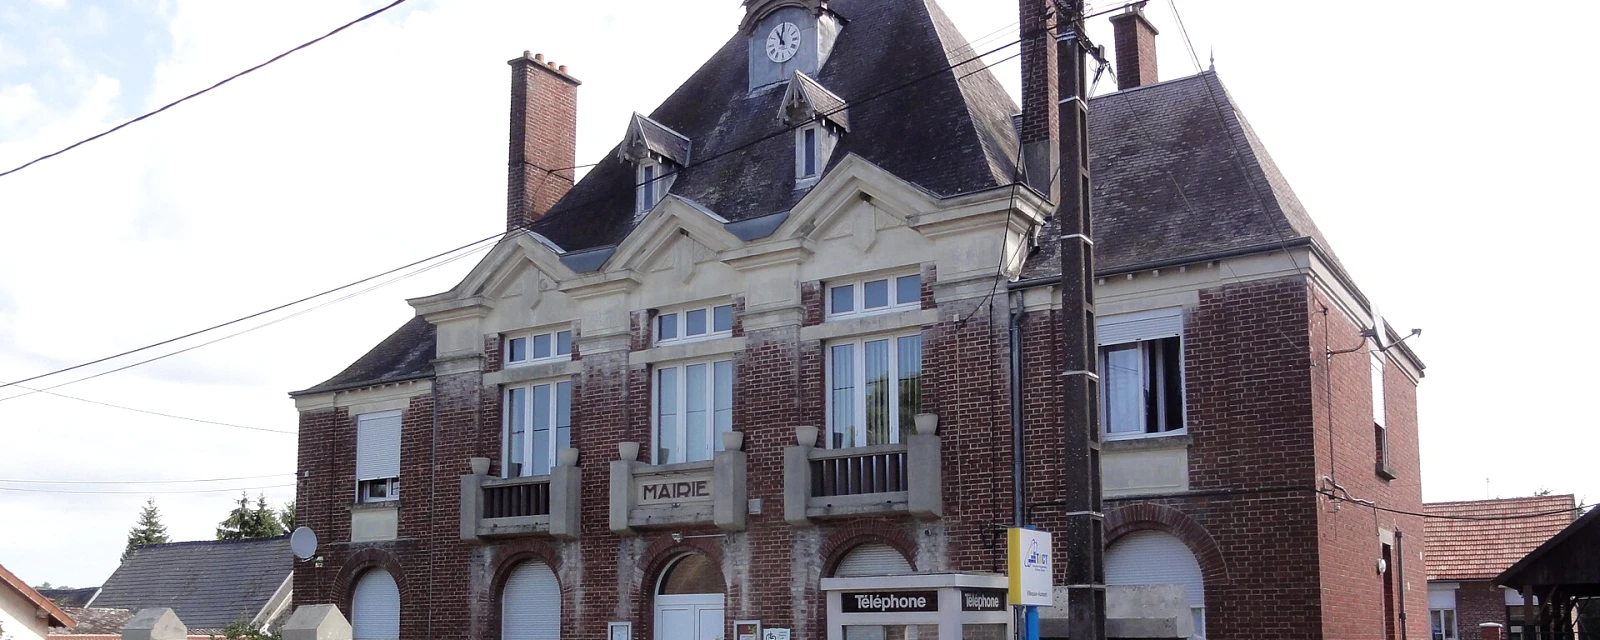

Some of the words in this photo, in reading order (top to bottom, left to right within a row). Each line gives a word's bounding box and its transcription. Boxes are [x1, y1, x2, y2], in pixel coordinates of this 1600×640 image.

[642, 480, 710, 500] MAIRIE
[854, 593, 927, 611] Téléphone
[964, 592, 999, 610] Téléphone
